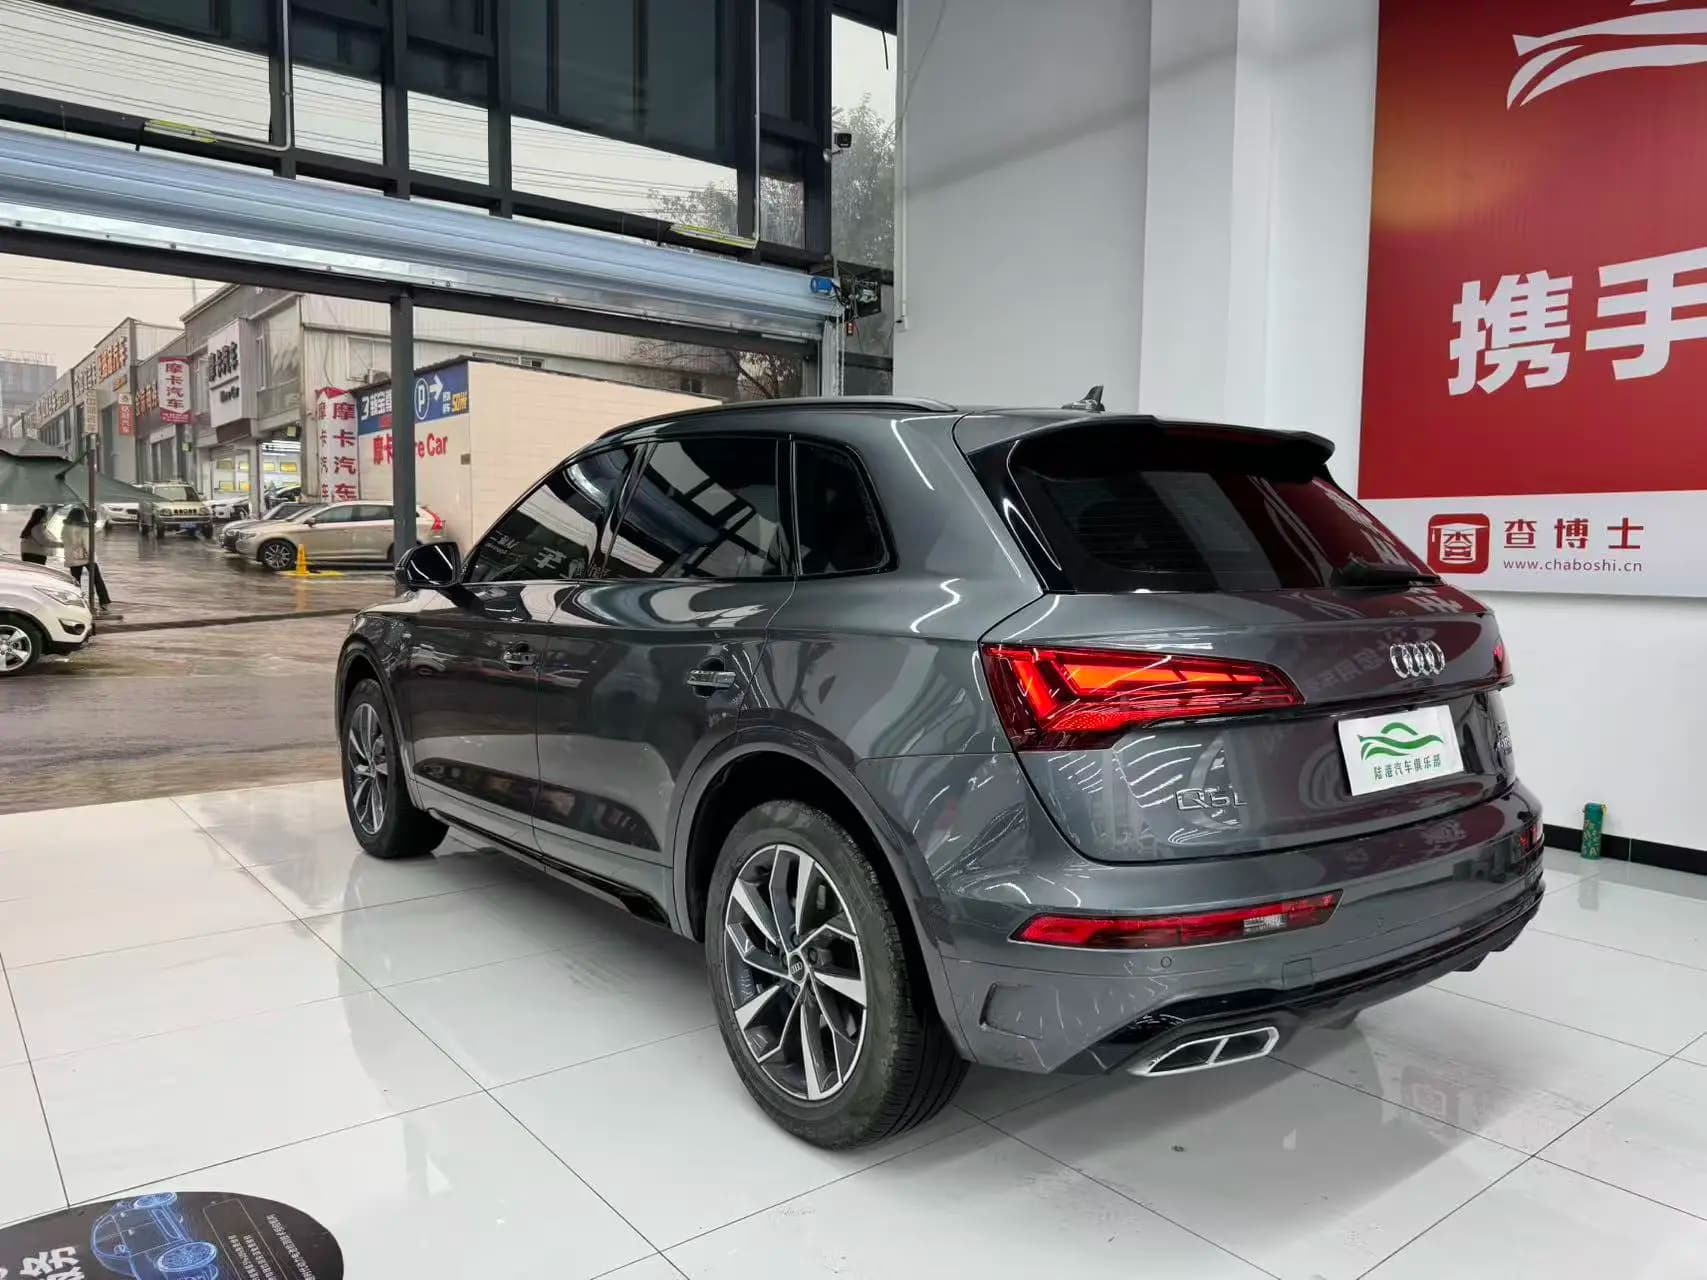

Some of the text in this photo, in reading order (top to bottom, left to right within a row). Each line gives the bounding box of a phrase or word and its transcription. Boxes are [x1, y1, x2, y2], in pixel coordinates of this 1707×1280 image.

[1448, 247, 1707, 396] 携手
[165, 363, 184, 409] 摩卡汽车
[333, 402, 357, 502] 摩卡汽车
[427, 432, 448, 456] Car
[1504, 518, 1644, 549] 查博士
[1503, 558, 1643, 573] www.chaboshi.cn
[1176, 787, 1247, 810] Q5L
